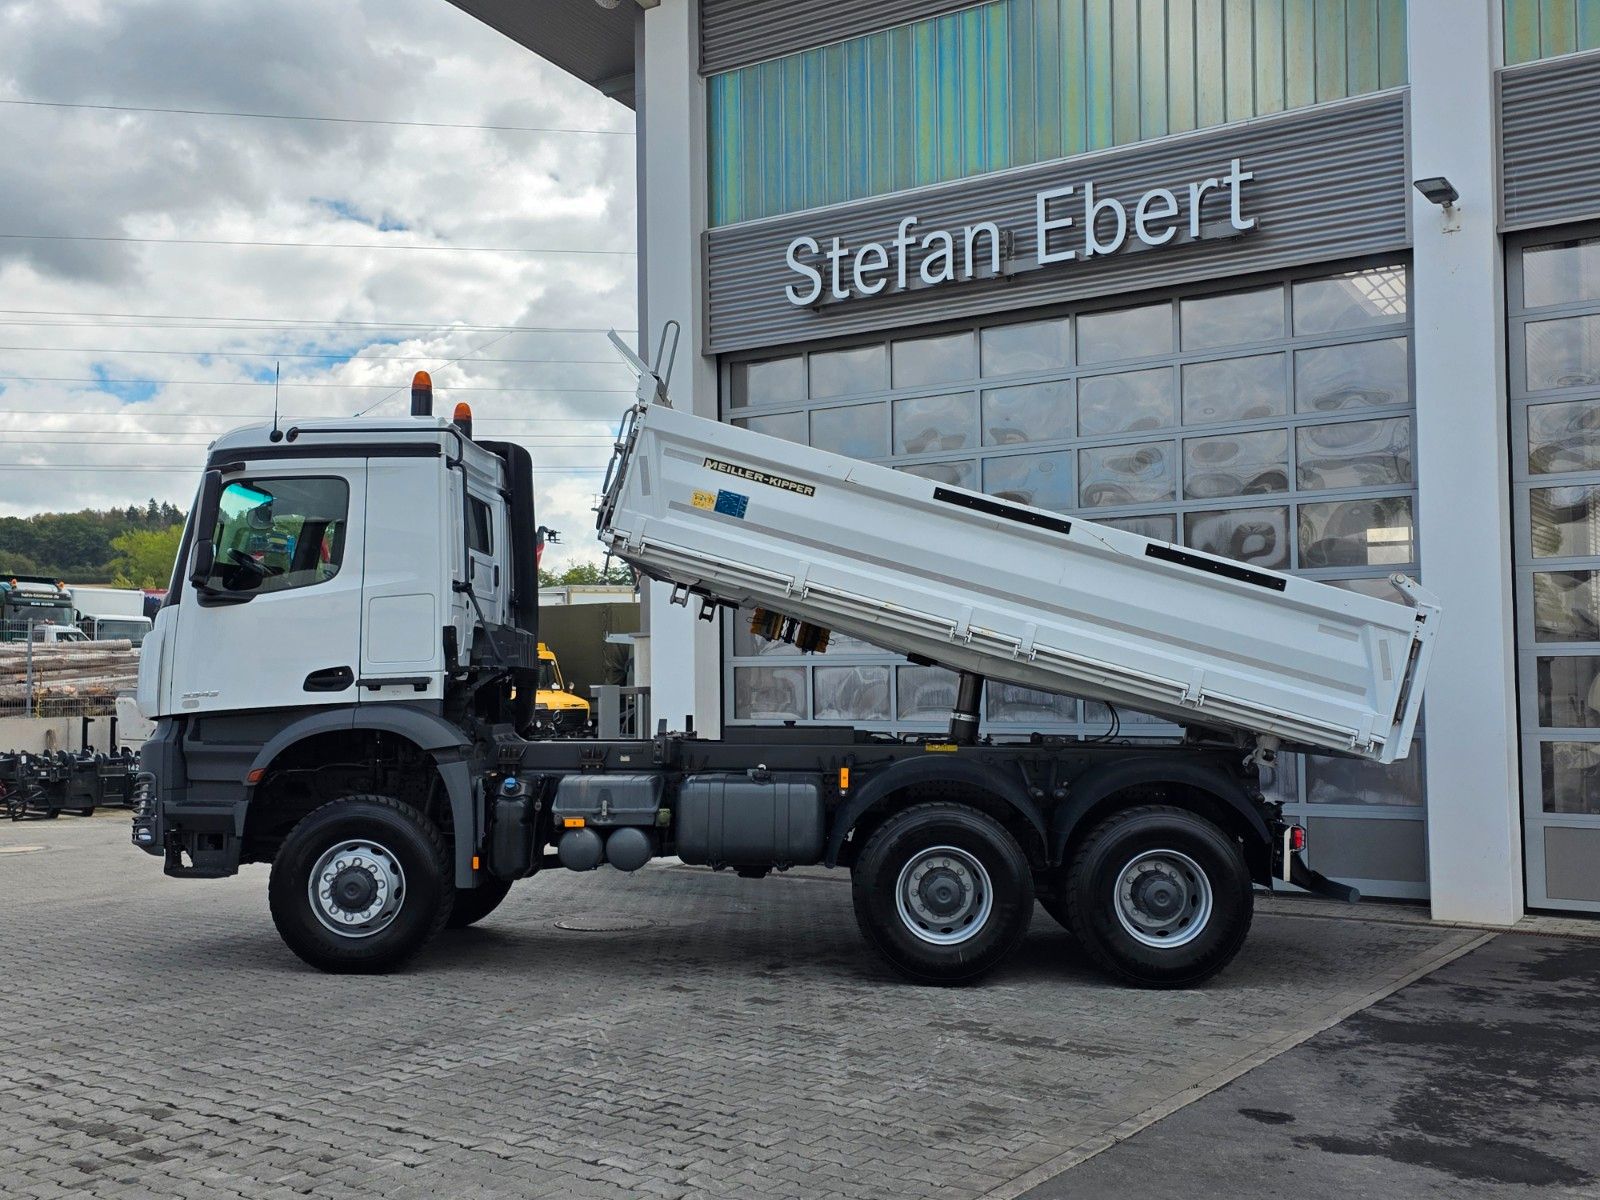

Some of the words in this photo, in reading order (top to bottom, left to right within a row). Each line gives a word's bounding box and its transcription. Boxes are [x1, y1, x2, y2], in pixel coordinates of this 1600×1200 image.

[785, 216, 1000, 306] Stefan
[1036, 158, 1255, 265] Ebert
[705, 459, 813, 496] MEILLER-KIPPER
